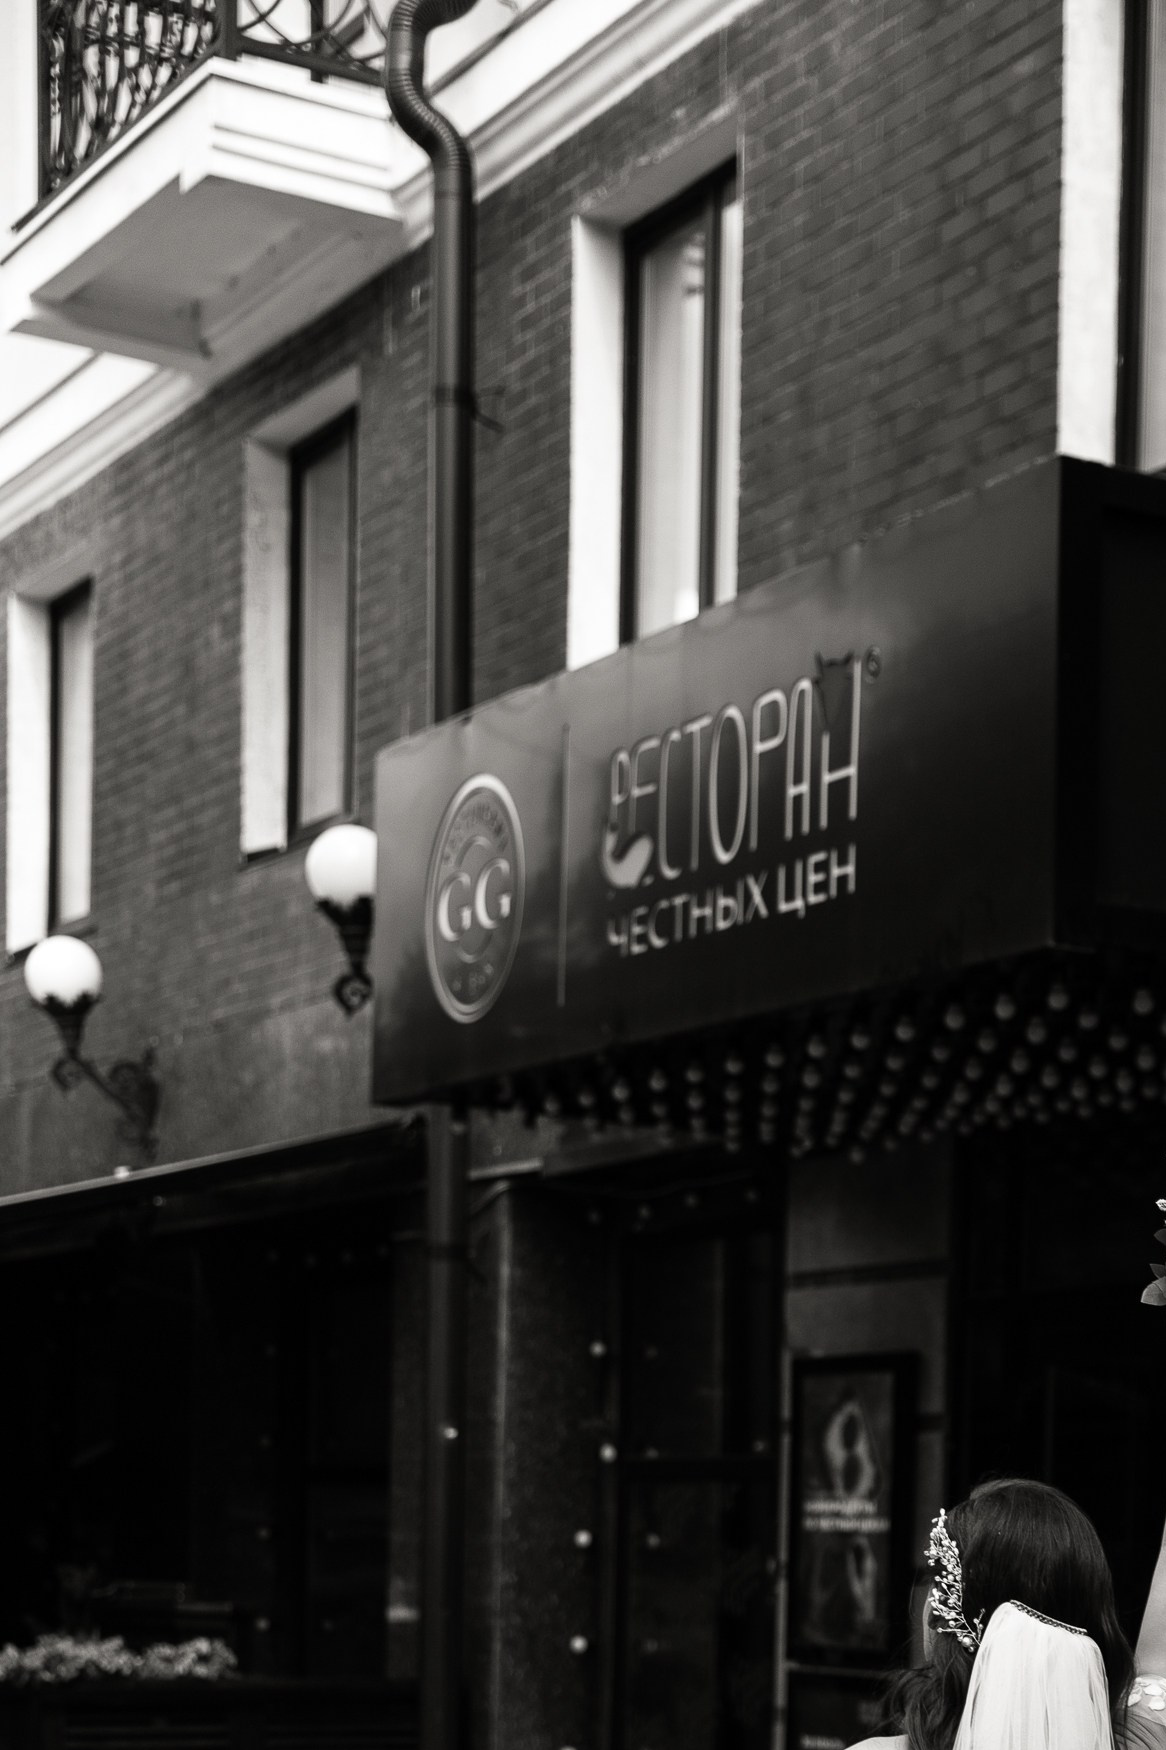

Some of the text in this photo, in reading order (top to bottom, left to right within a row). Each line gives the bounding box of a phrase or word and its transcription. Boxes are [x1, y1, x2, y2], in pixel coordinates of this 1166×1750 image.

[604, 655, 862, 888] РЕСТОРАН
[607, 843, 856, 957] ЧЕСТНЫХ ЦЕН
